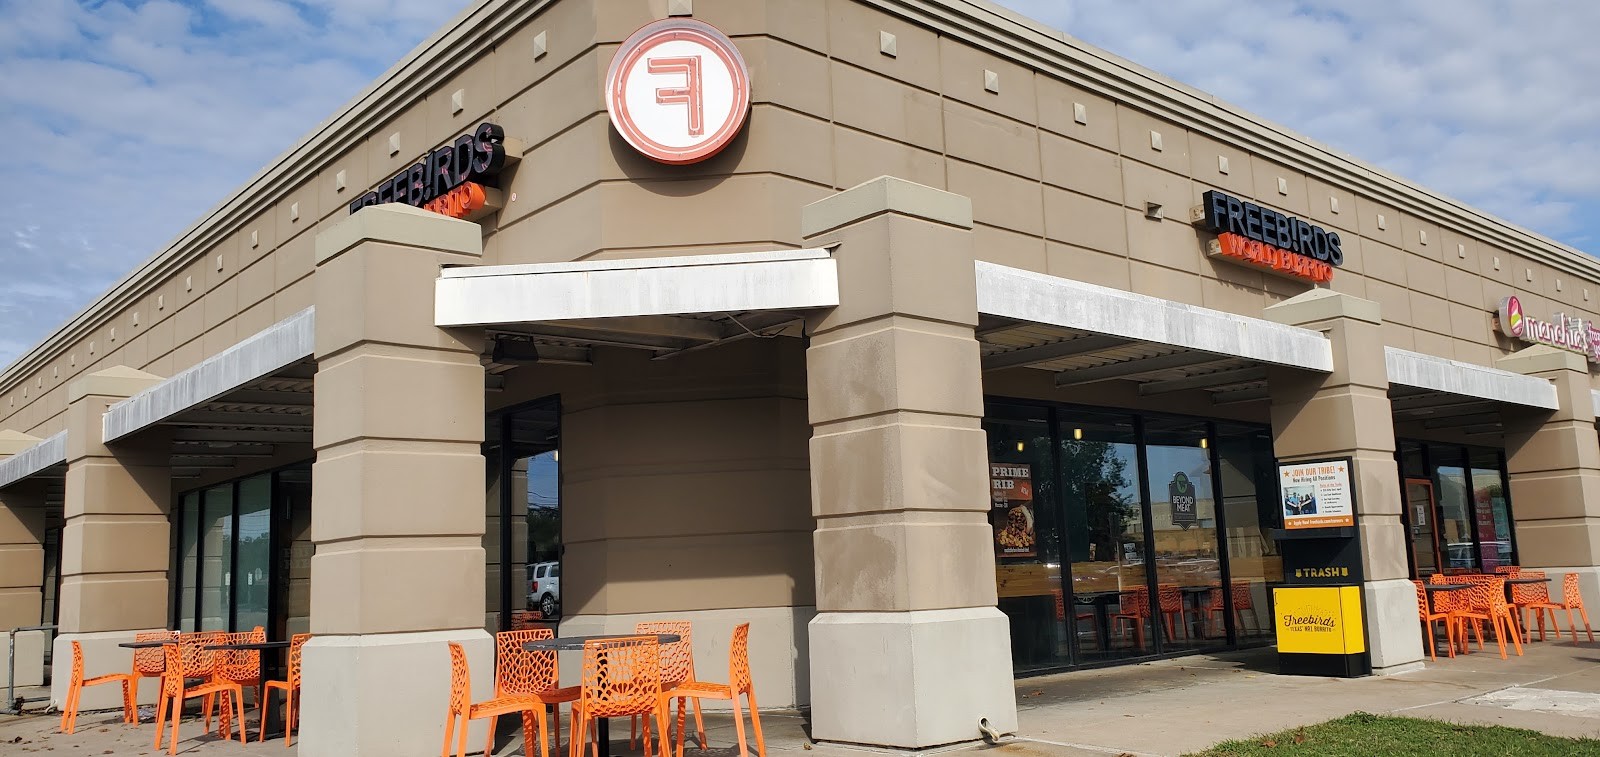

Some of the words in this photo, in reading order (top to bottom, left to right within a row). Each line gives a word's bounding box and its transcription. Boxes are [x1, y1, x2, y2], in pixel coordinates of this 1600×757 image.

[1205, 190, 1343, 266] FREEB!RDS
[1221, 232, 1277, 266] WORLD
[1279, 250, 1333, 282] BURRITO
[992, 466, 1029, 477] PRIME
[1292, 468, 1304, 477] JOIN
[1306, 467, 1316, 476] OUR
[1318, 465, 1335, 475] TRIBE!
[993, 479, 1015, 489] RIB
[1172, 495, 1193, 504] BEYOND
[1176, 503, 1190, 512] MEAT
[1303, 567, 1339, 578] TRASH
[1283, 614, 1336, 628] Freebirds
